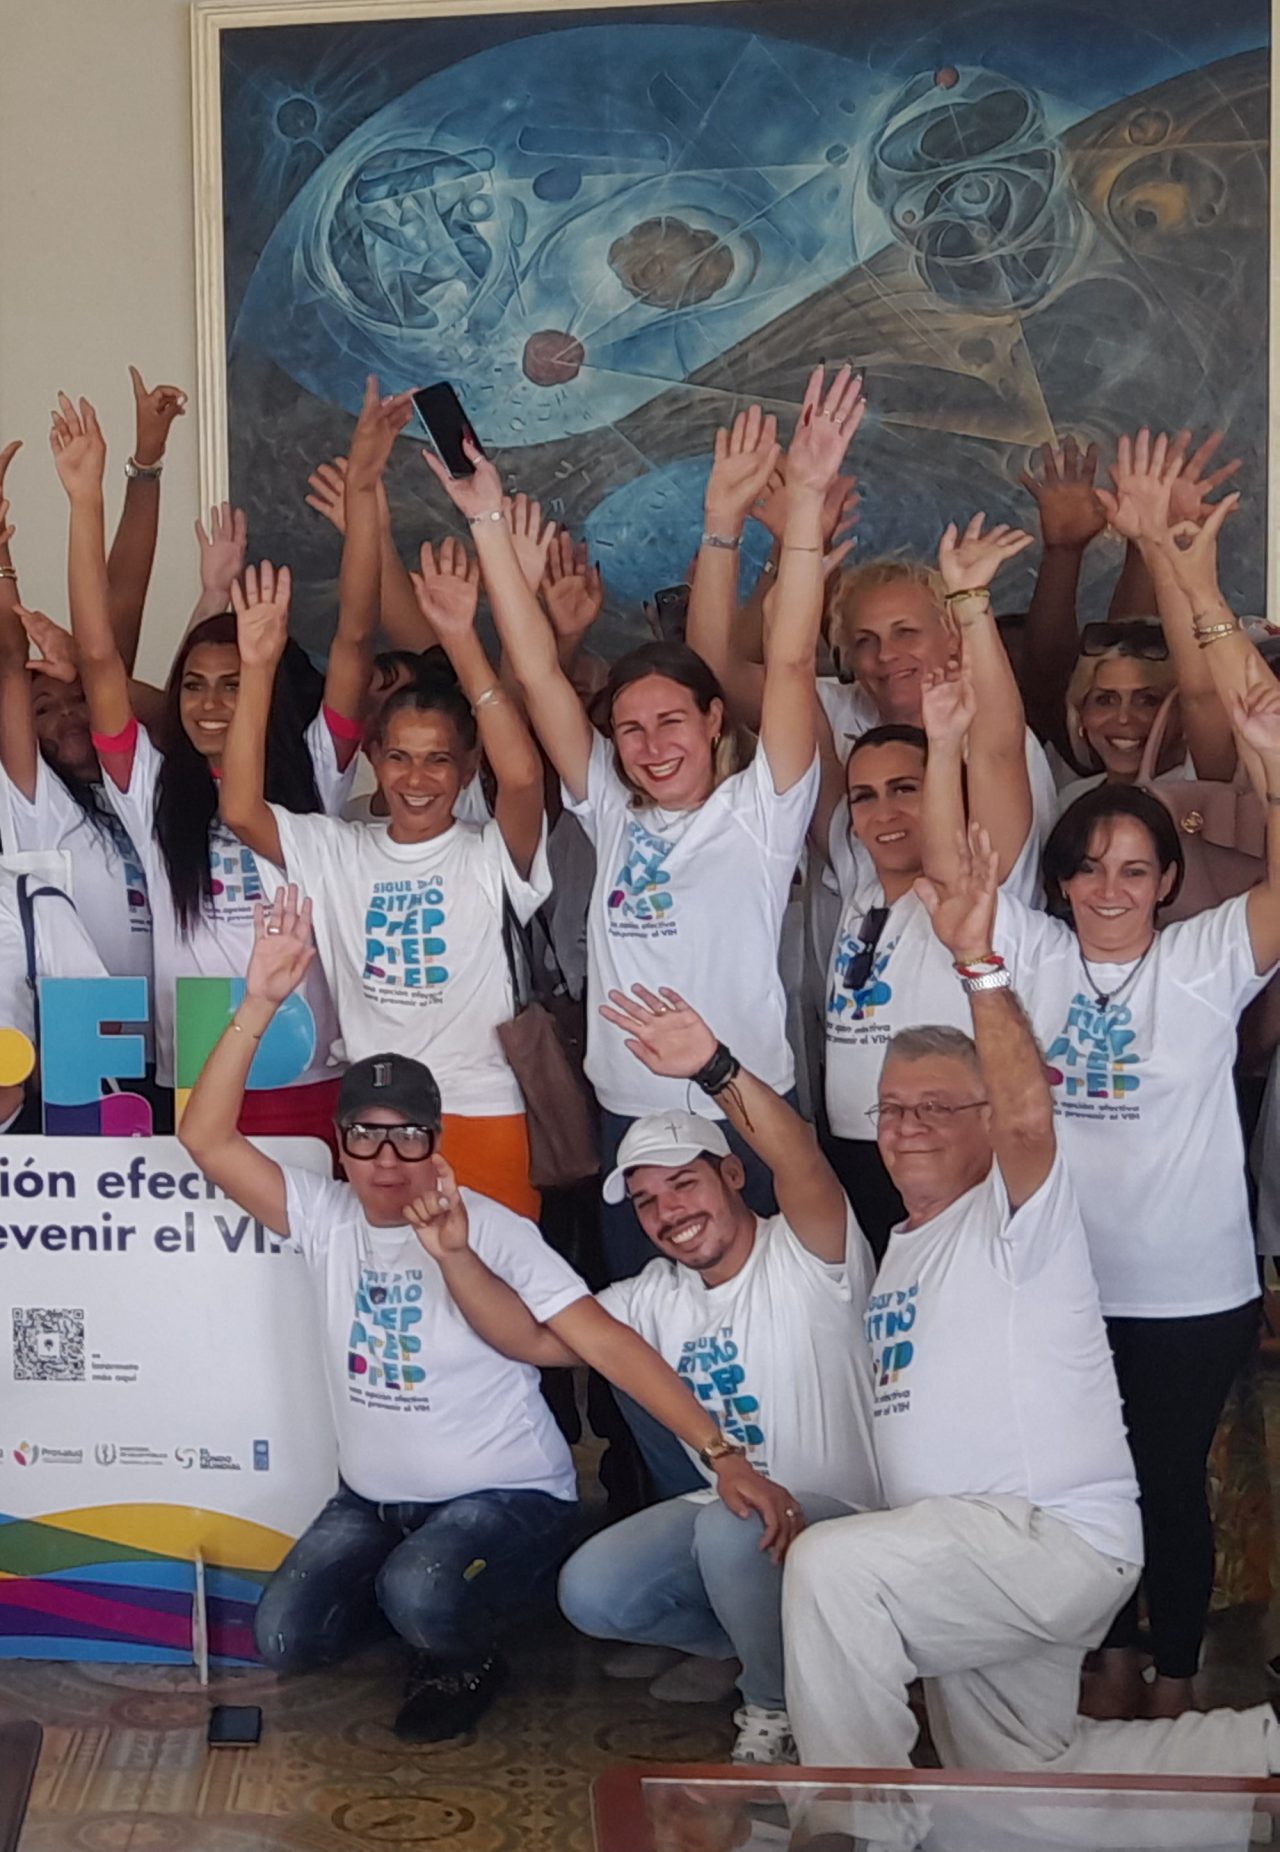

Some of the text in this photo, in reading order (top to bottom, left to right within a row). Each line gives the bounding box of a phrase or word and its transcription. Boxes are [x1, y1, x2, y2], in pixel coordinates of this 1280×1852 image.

[370, 888, 444, 912] RITMO
[373, 880, 412, 893] SIGUE
[365, 908, 445, 936] PrEP
[365, 937, 447, 964] PrEP
[362, 962, 449, 989] PrEP
[96, 1156, 234, 1200] efec
[153, 1211, 196, 1253] el
[213, 1214, 304, 1255] VI
[866, 1303, 917, 1342] ITMO
[349, 1320, 422, 1361] PrEP
[348, 1351, 427, 1391] PrEP
